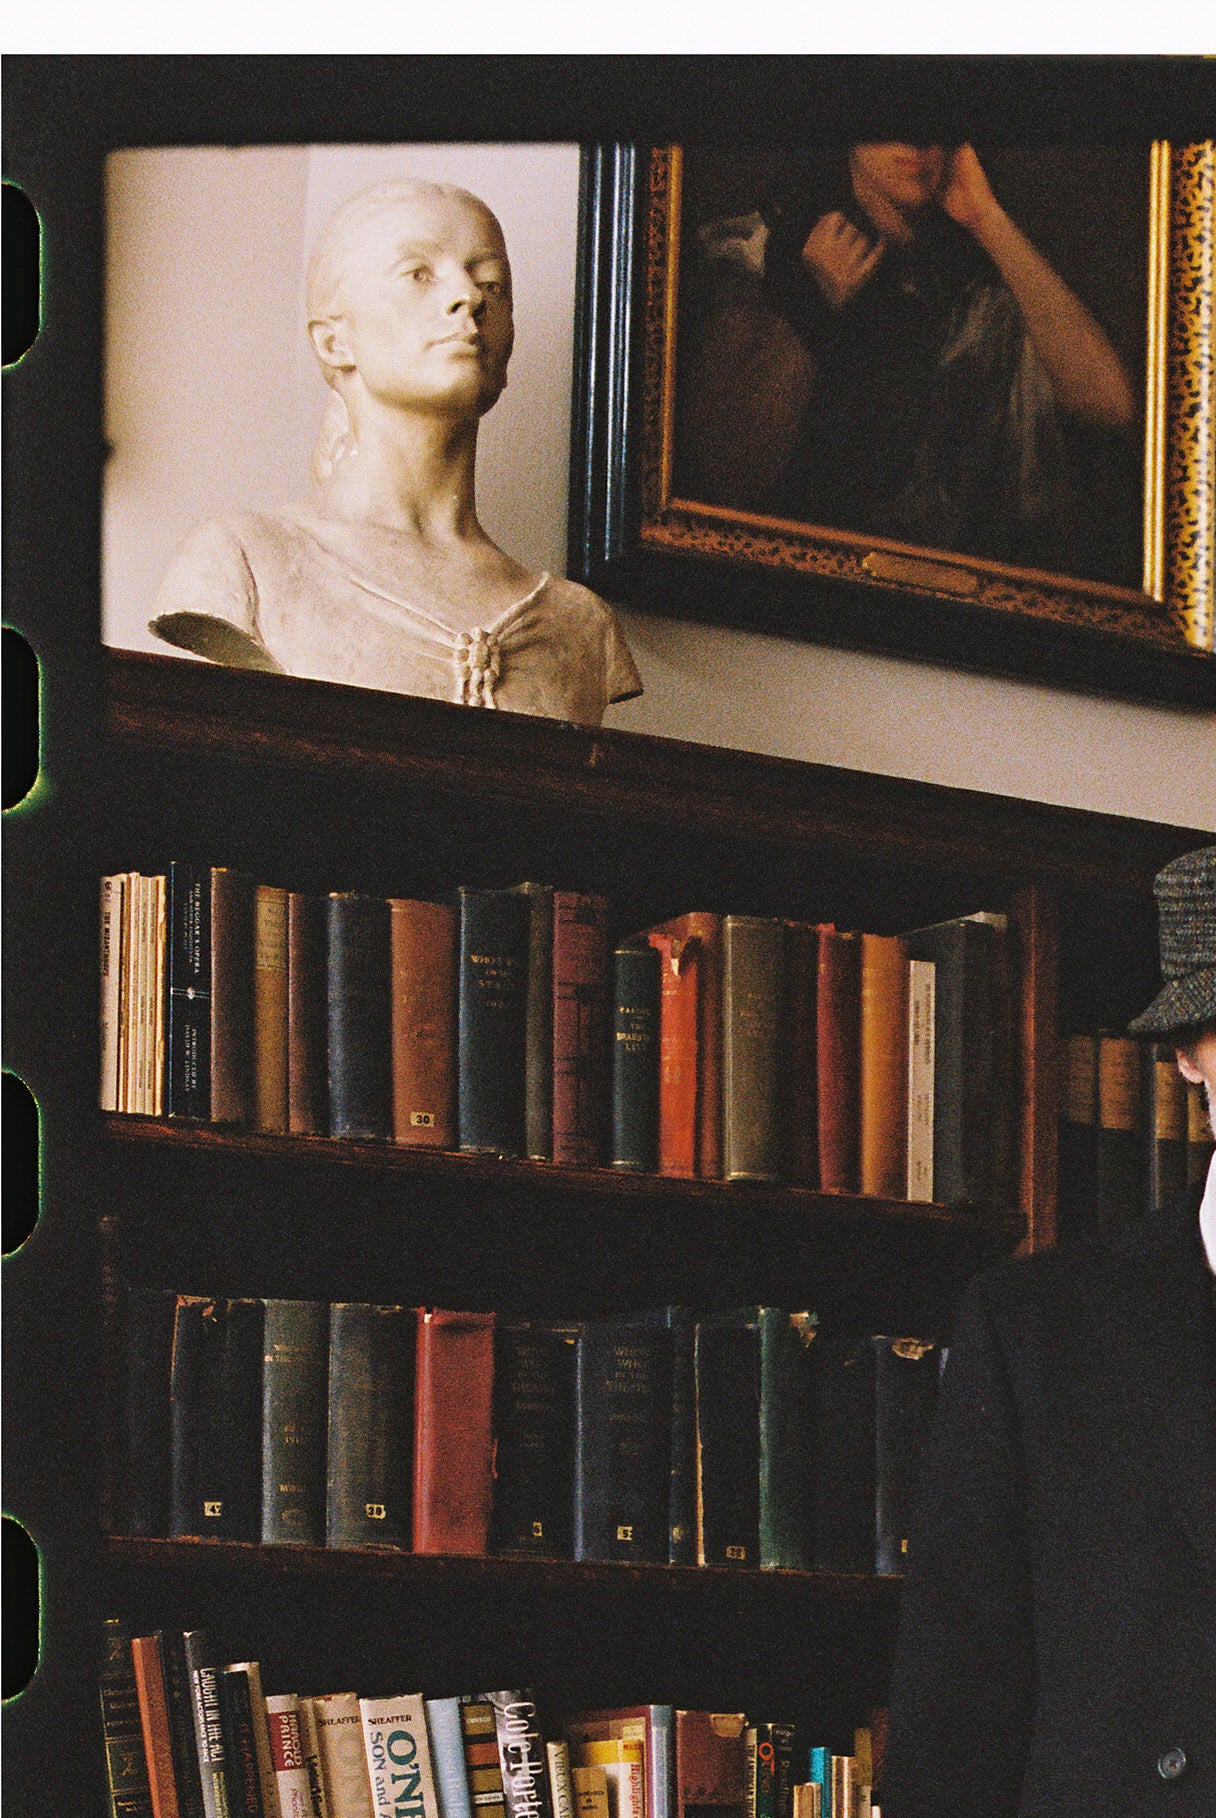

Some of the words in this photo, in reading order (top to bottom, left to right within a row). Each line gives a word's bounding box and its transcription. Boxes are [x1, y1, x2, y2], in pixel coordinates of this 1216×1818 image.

[193, 946, 201, 974] OPERA
[416, 1115, 430, 1124] 30
[200, 1668, 219, 1708] CAUGHT
[196, 1702, 205, 1723] ACTORS
[205, 1710, 220, 1721] IN
[367, 1715, 412, 1725] SHEAFFER
[502, 1701, 539, 1754] Cole
[208, 1724, 222, 1741] THE
[279, 1715, 294, 1768] PRINCE
[288, 1714, 302, 1766] HAROLD
[210, 1744, 225, 1762] ACT
[370, 1731, 385, 1772] SON
[241, 1739, 257, 1813] HAPPENED
[553, 1751, 567, 1792] VIEUX
[629, 1763, 643, 1814] Highlights
[376, 1777, 391, 1806] and
